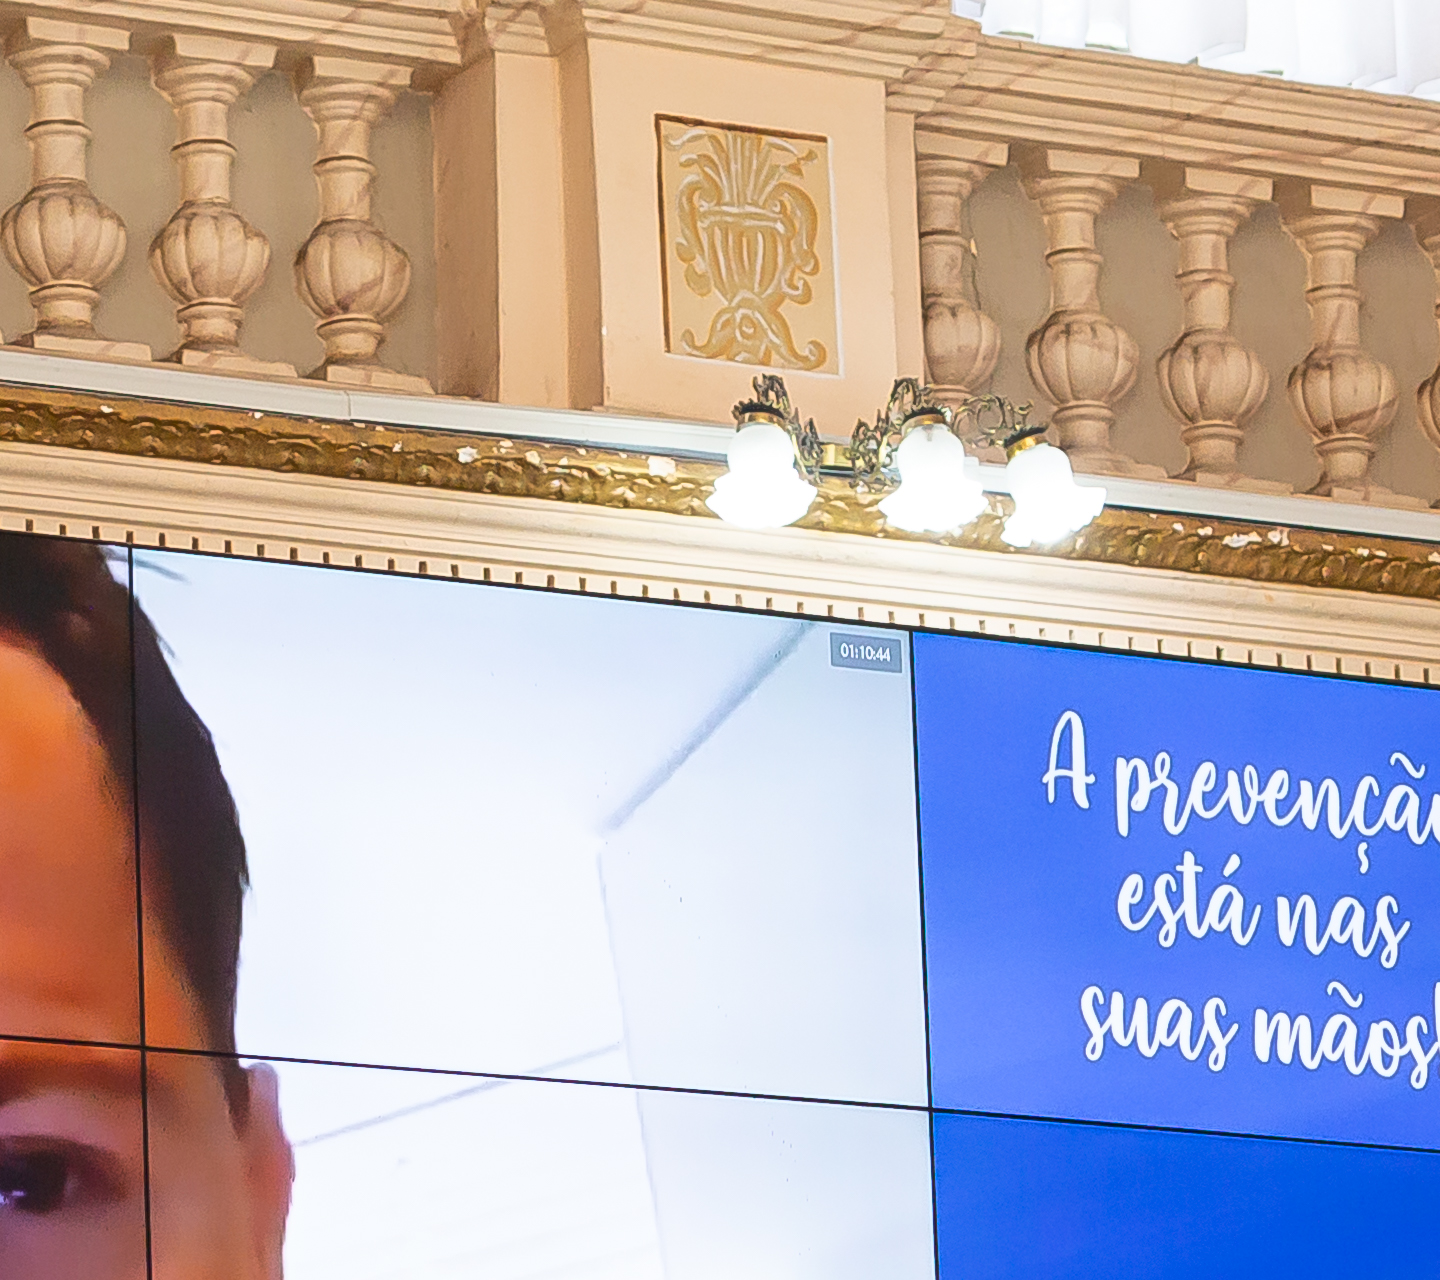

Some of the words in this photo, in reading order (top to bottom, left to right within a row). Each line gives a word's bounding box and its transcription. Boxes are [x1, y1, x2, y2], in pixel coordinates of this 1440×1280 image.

[840, 642, 891, 662] 01:10:44
[1042, 710, 1095, 809] A
[1117, 850, 1261, 948] está
[1277, 893, 1411, 969] nas
[1080, 984, 1238, 1072] suas
